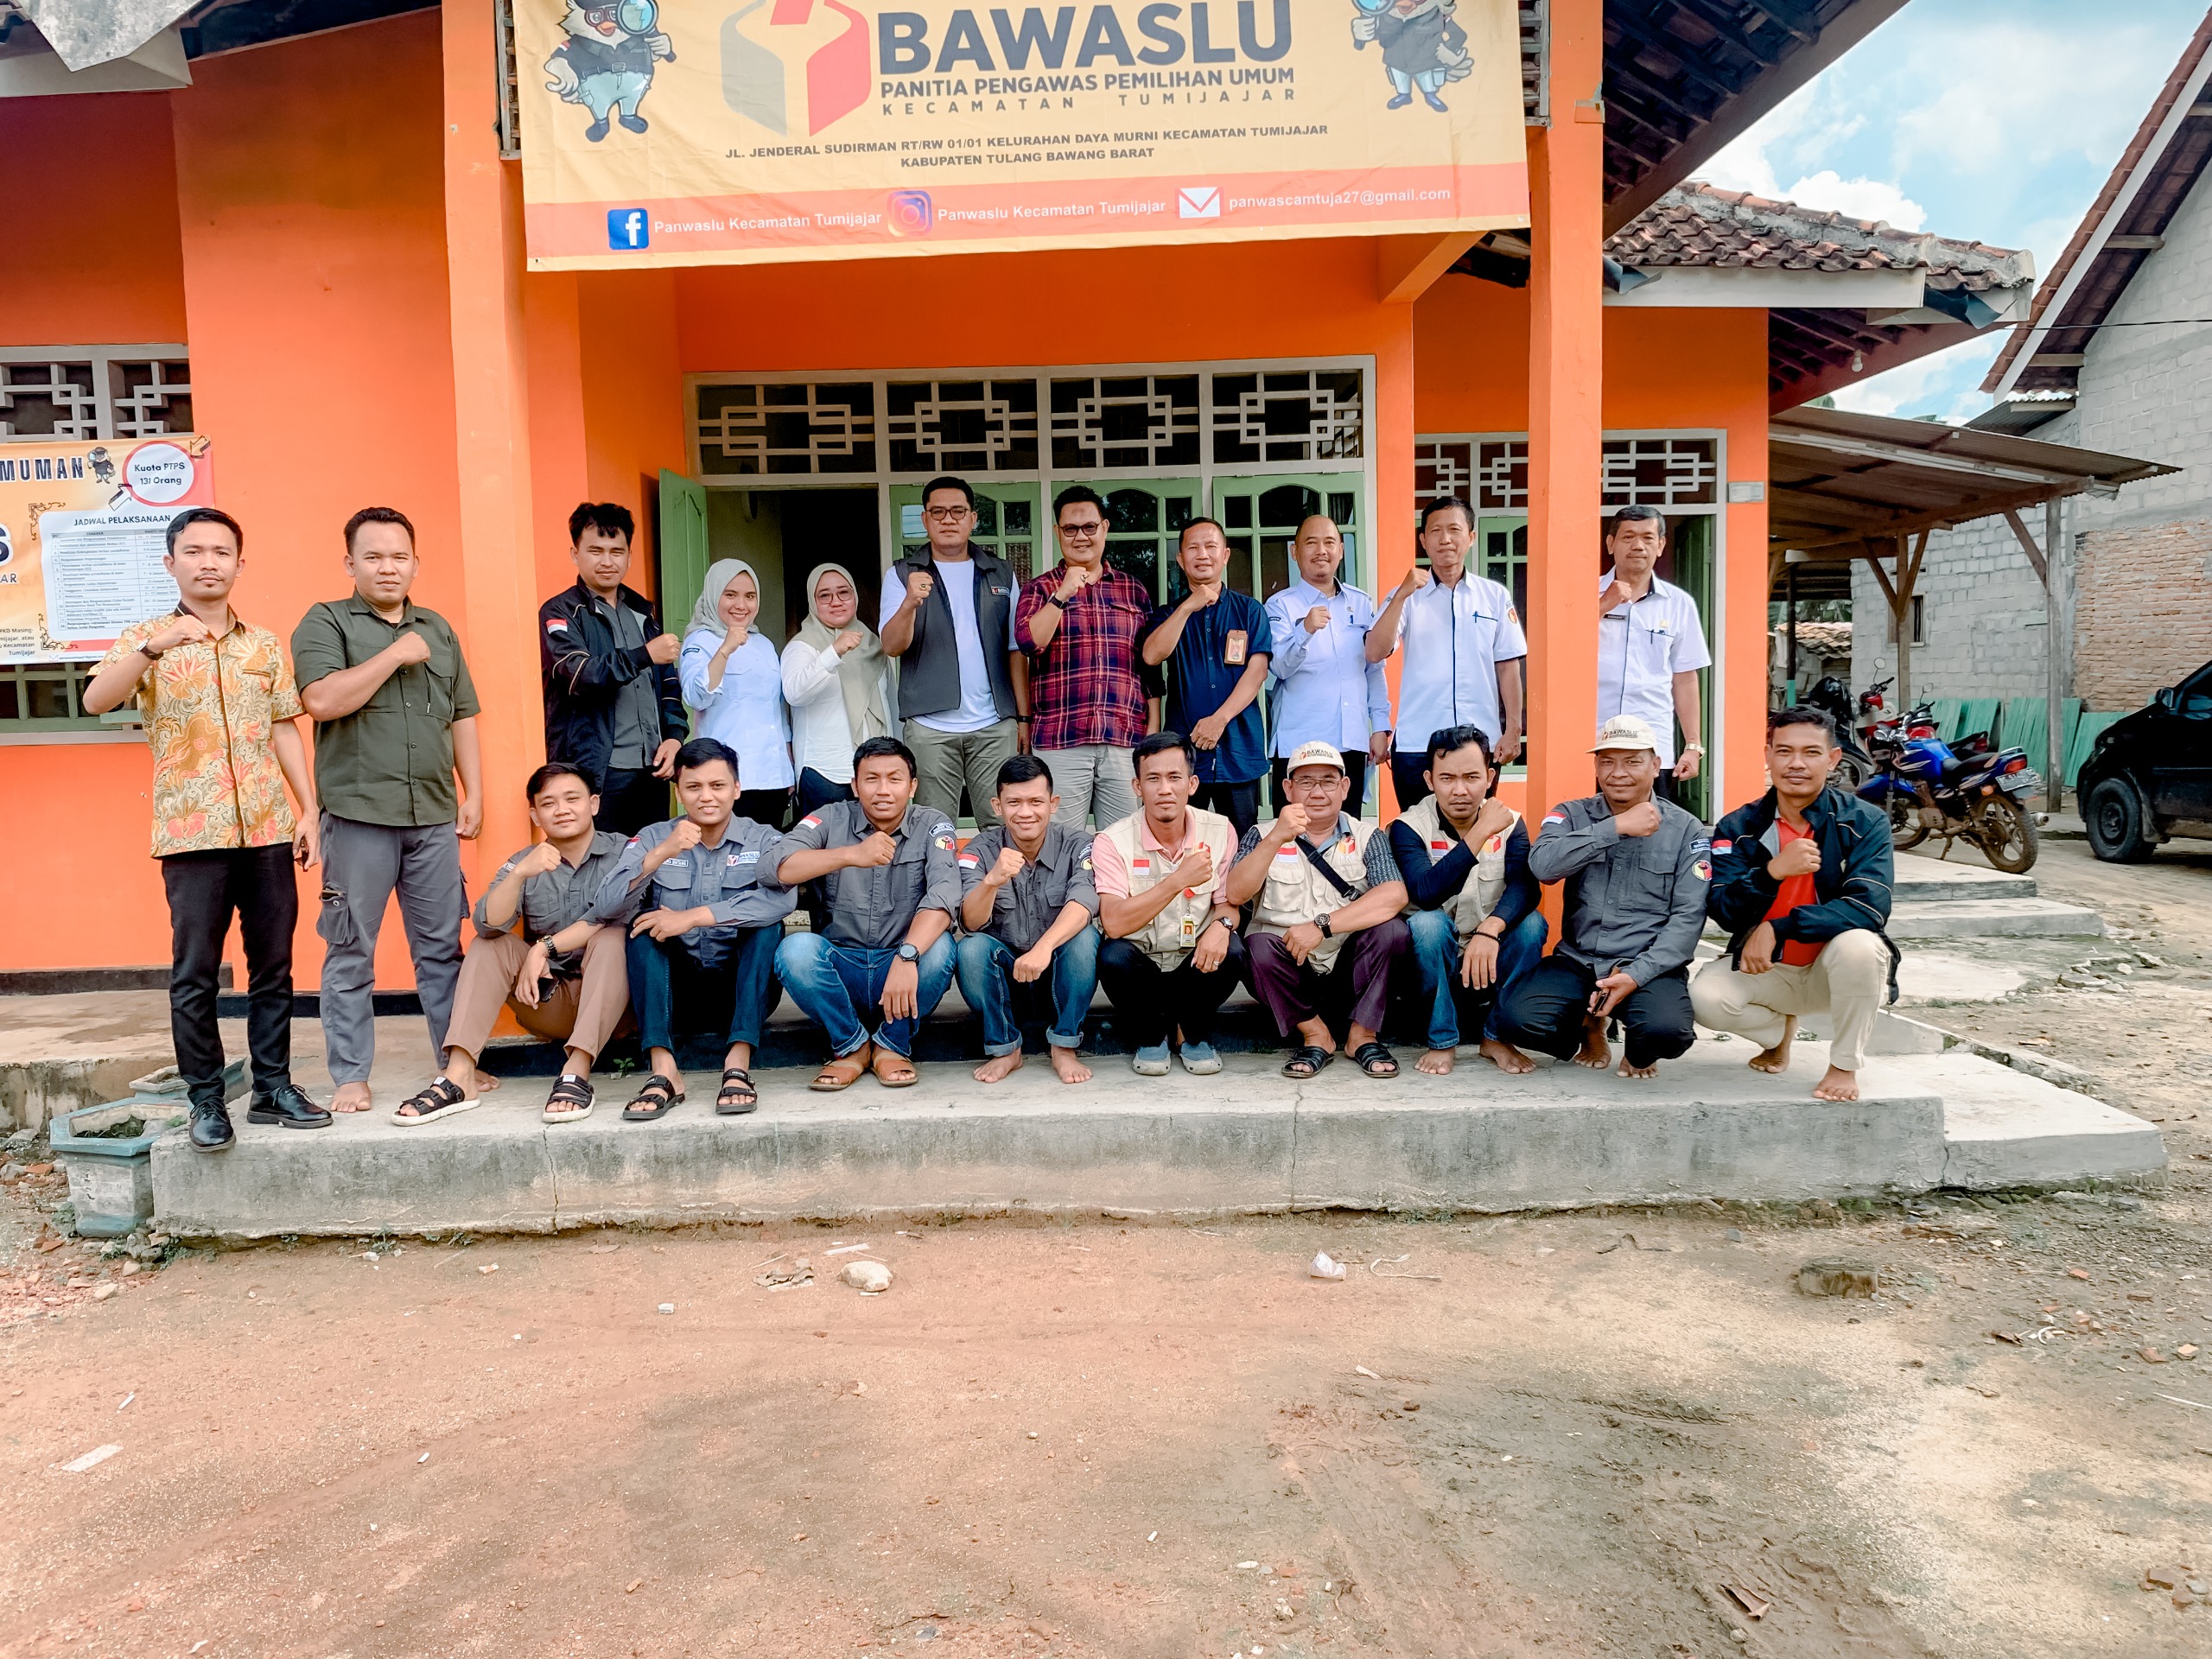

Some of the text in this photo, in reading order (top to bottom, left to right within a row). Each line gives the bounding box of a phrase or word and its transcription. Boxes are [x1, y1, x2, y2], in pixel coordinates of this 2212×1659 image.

[878, 0, 1292, 75] BAWASLU
[880, 67, 1294, 99] PANITIA PENGAWAS PEMILIHAN UMUM
[882, 88, 1294, 116] KECAMATAN TUMIJAJAR
[725, 124, 1329, 159] JL. JENDERAL SUDIRMAN RT/RW 01/01 KELURAHAN DAYA MURNI KECAMATAN TUMIJAJAR
[900, 148, 1155, 168] KABUPATEN TULANG BAWANG BARAT
[1229, 188, 1452, 211] panwascamtuja27@gmail.com
[938, 200, 1166, 221] Panwaslu Kecamatan Tumijajar
[654, 212, 882, 233] Panwaslu Kecamatan Tumijajar
[134, 461, 186, 472] Kuota PTPS
[153, 476, 182, 486] Orang
[73, 514, 171, 526] JADWAL PELAKSANAAN
